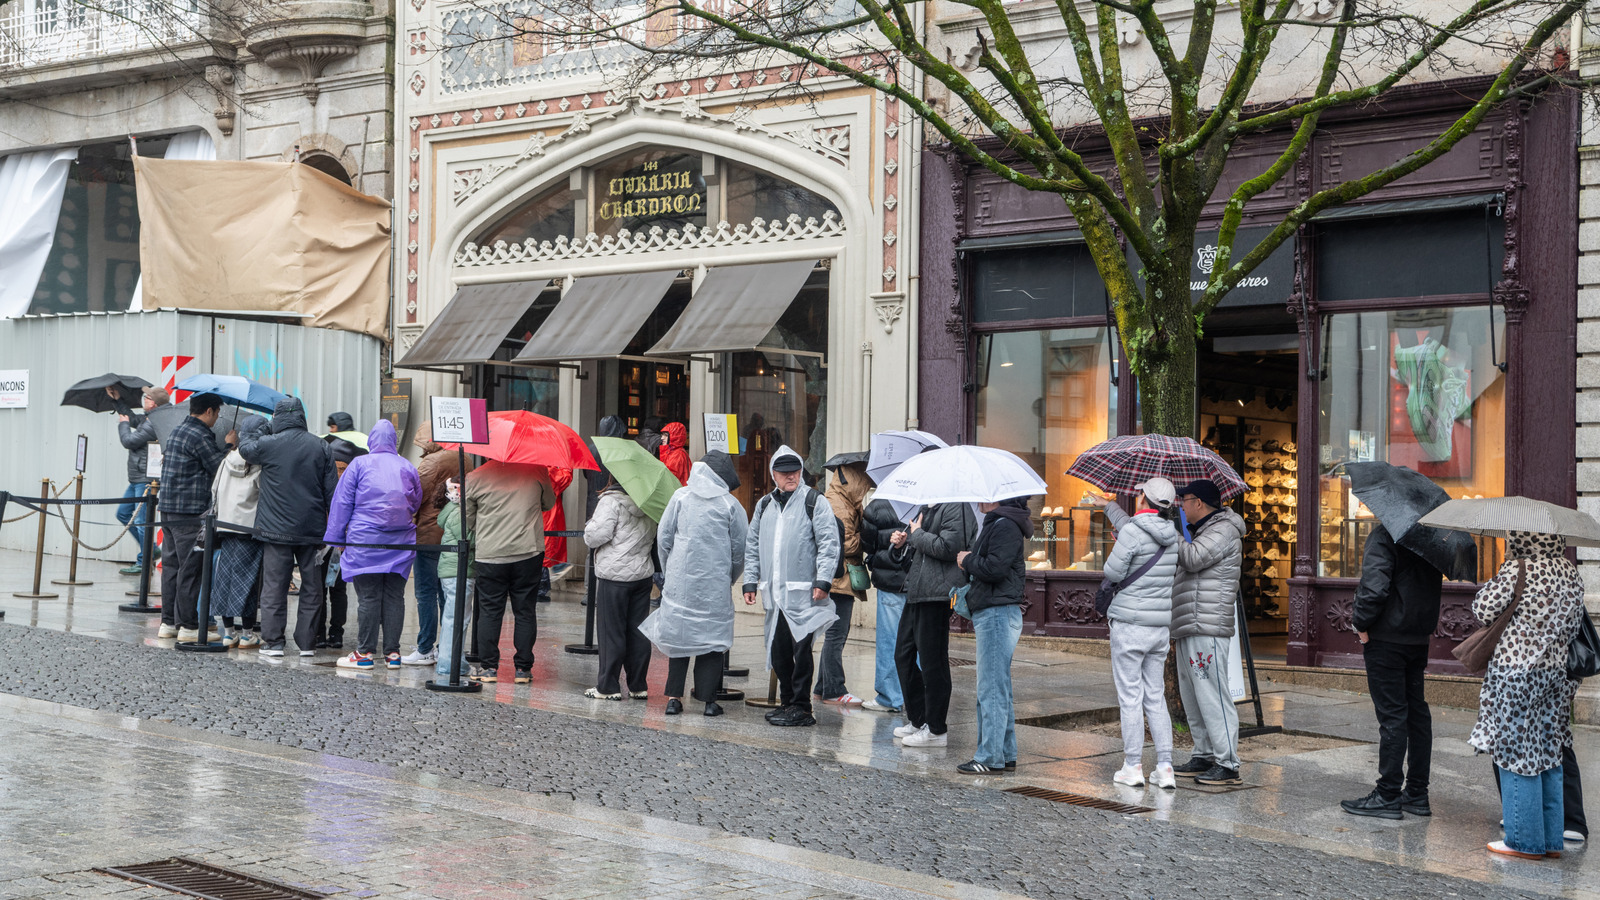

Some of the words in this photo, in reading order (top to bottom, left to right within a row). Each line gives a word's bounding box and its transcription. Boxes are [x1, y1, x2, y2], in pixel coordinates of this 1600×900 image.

[643, 161, 658, 172] 144
[609, 170, 693, 196] LIVRARIA
[600, 193, 701, 220] CHARDRON
[1236, 276, 1269, 288] ares
[438, 416, 465, 429] 11:45
[707, 430, 726, 442] 12:00
[1231, 688, 1244, 697] ELLO
